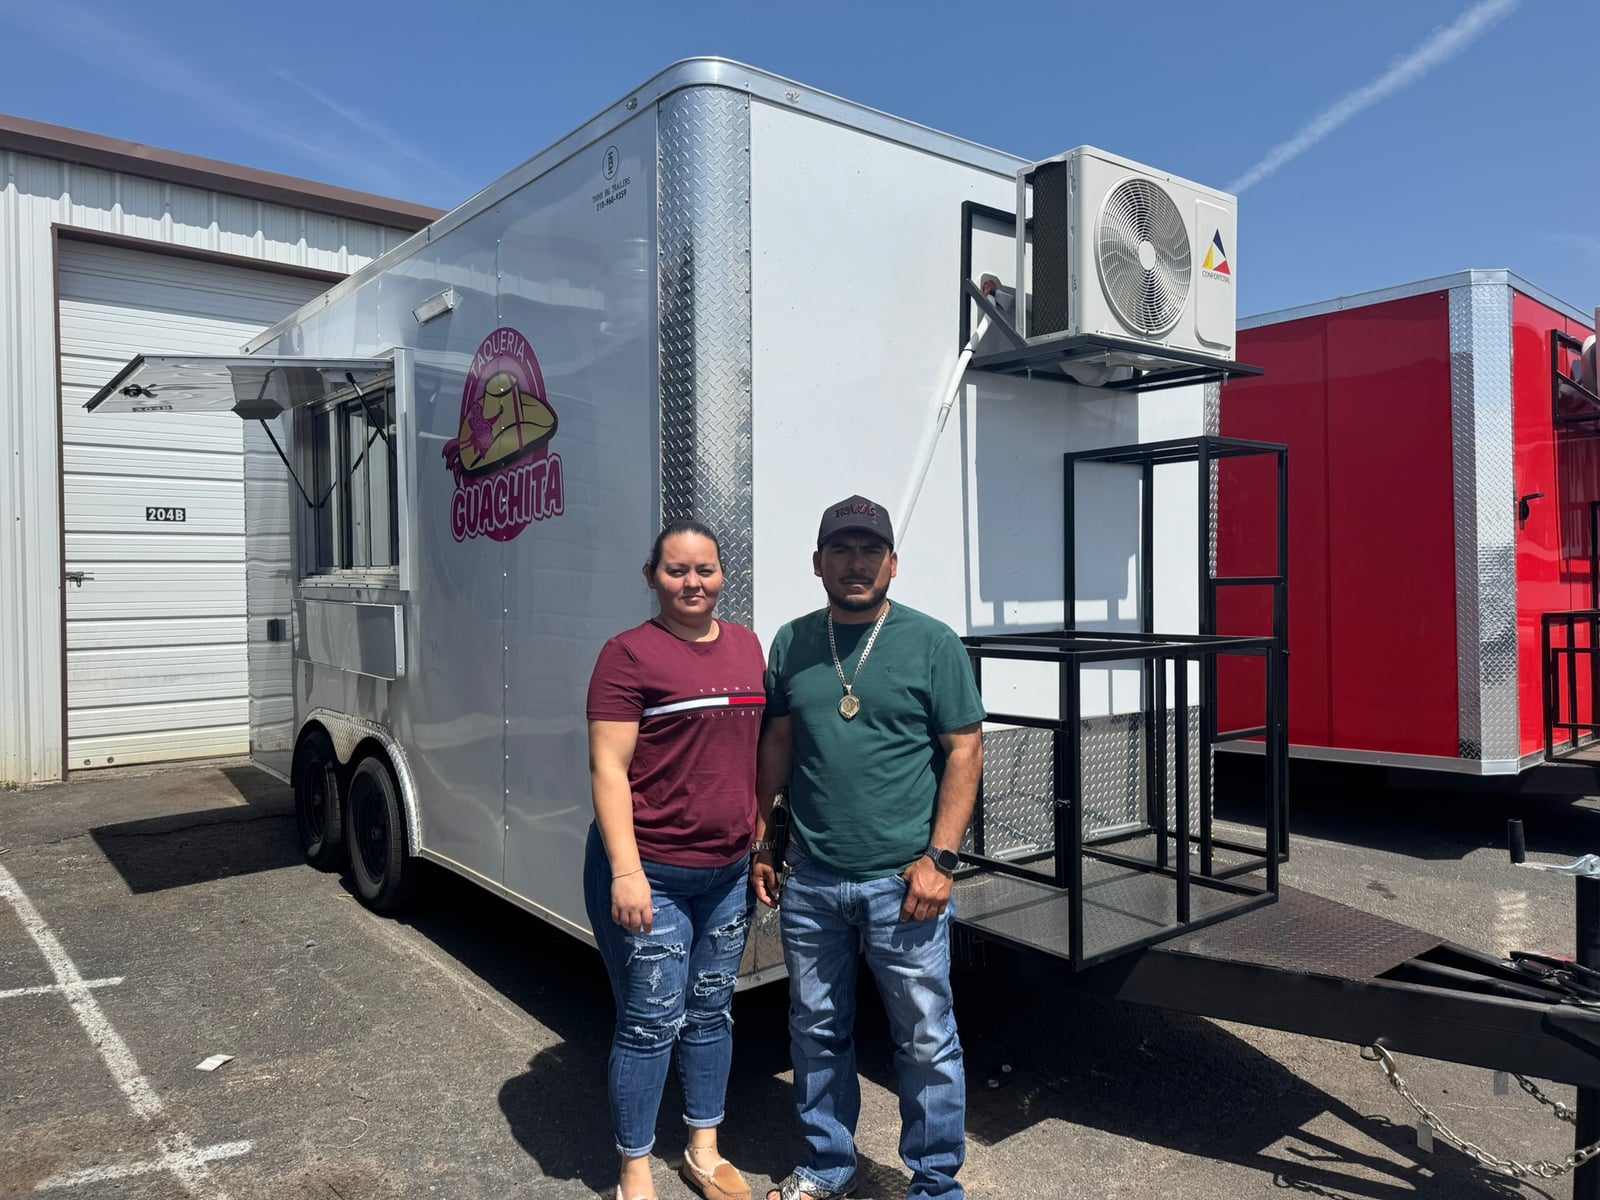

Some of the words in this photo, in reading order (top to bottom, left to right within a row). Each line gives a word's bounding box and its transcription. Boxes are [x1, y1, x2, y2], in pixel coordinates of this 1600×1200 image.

[470, 330, 526, 379] TAQUERIA
[451, 453, 564, 542] GUACHITA
[148, 508, 184, 520] 204B
[686, 709, 764, 720] HILFIGE
